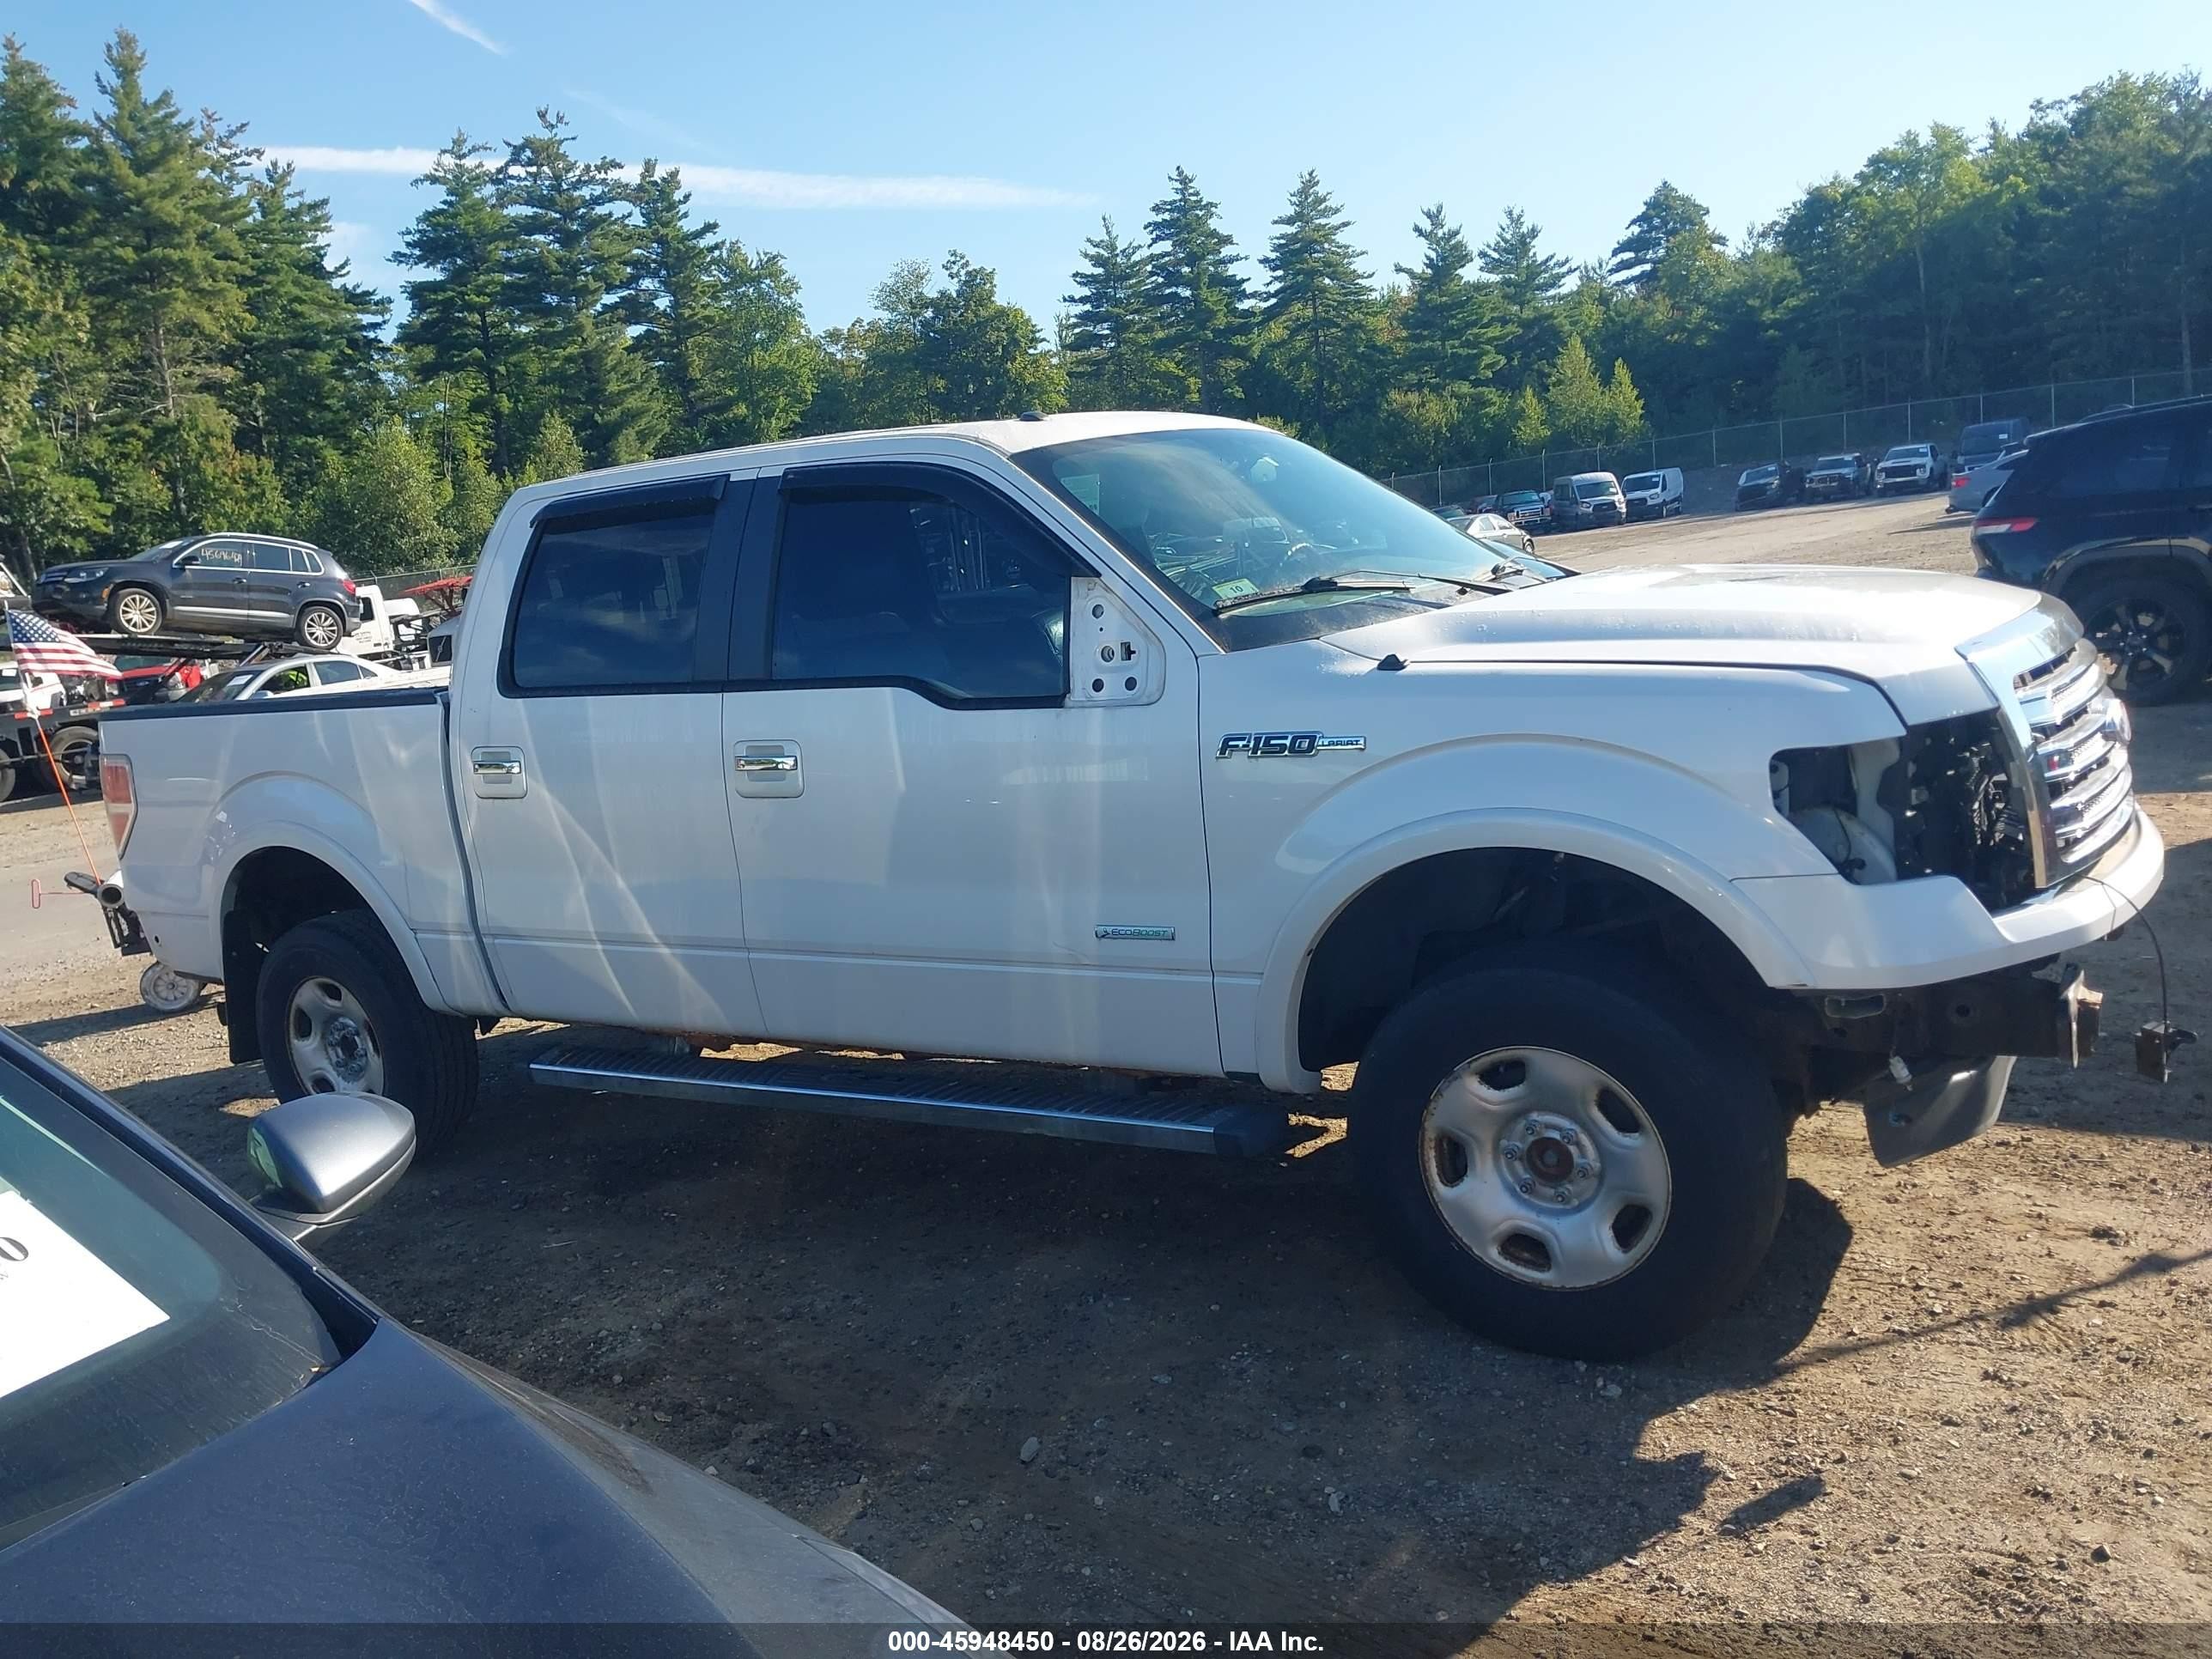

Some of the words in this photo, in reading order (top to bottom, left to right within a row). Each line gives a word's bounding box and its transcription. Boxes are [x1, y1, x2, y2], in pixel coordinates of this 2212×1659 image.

[1229, 585, 1244, 594] 10
[1217, 732, 1319, 757] F-150
[1320, 738, 1361, 747] LARIAT
